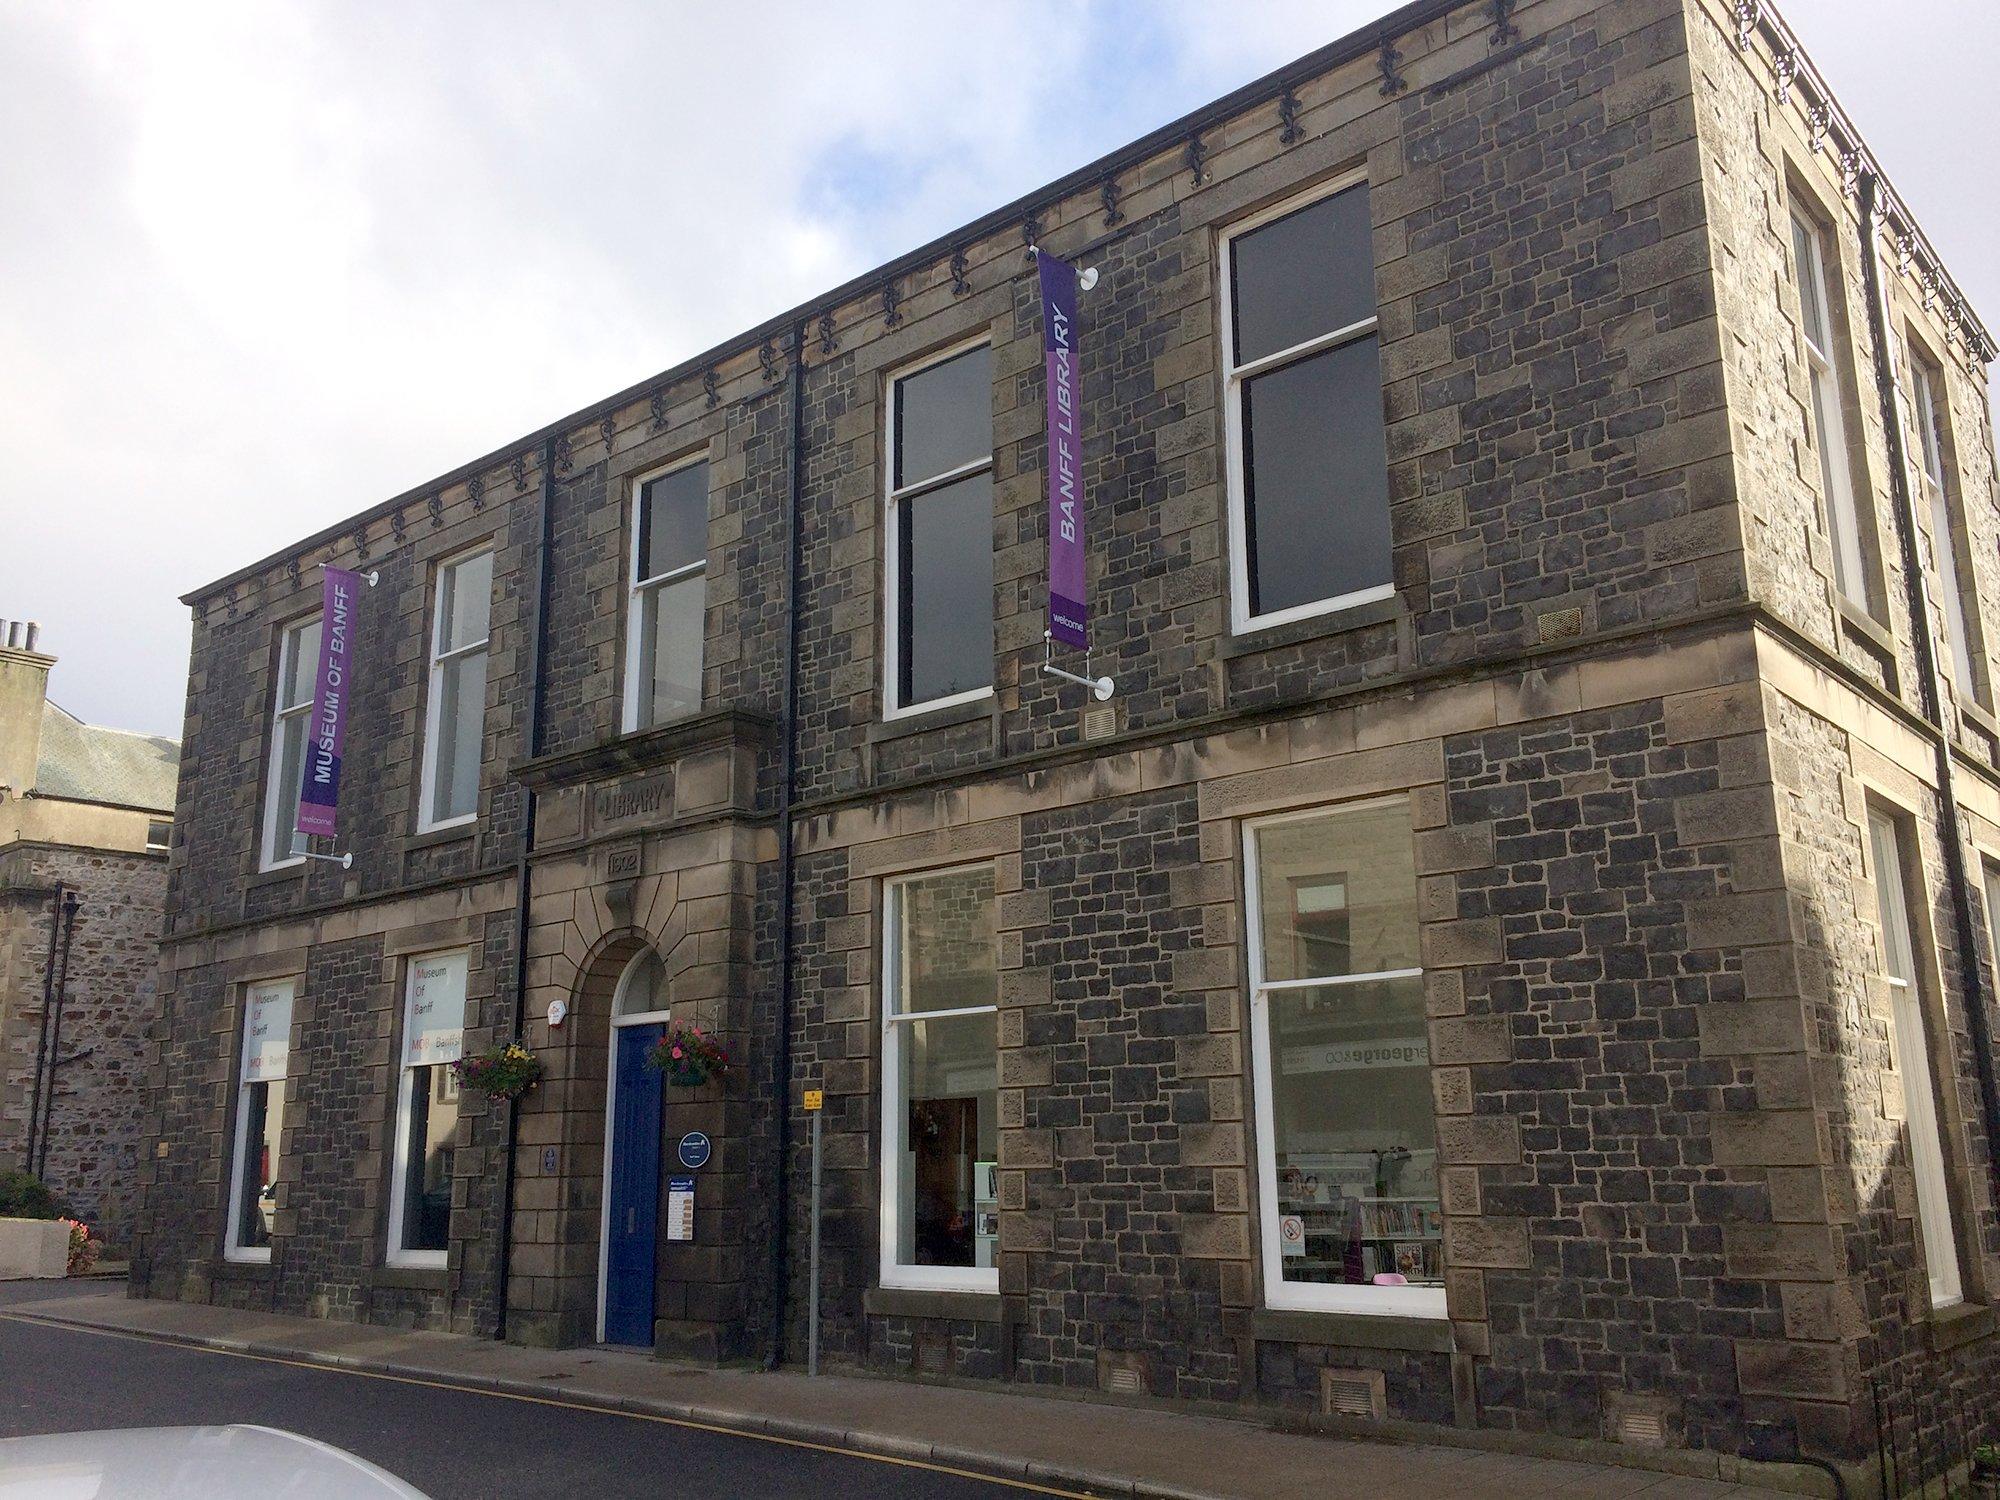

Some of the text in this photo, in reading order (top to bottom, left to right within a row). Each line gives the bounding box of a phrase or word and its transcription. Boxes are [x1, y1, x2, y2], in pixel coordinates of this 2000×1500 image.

[1052, 302, 1075, 544] BANFF LIBRARY
[1053, 612, 1084, 633] welcome
[314, 584, 349, 784] MUSEUM OF BANFF
[603, 783, 664, 821] LIBRARY
[301, 815, 333, 827] welcome
[612, 855, 637, 873] 1902
[416, 967, 447, 980] Museum
[255, 994, 280, 1004] Museum
[416, 985, 426, 997] Of
[414, 1001, 433, 1015] Banff
